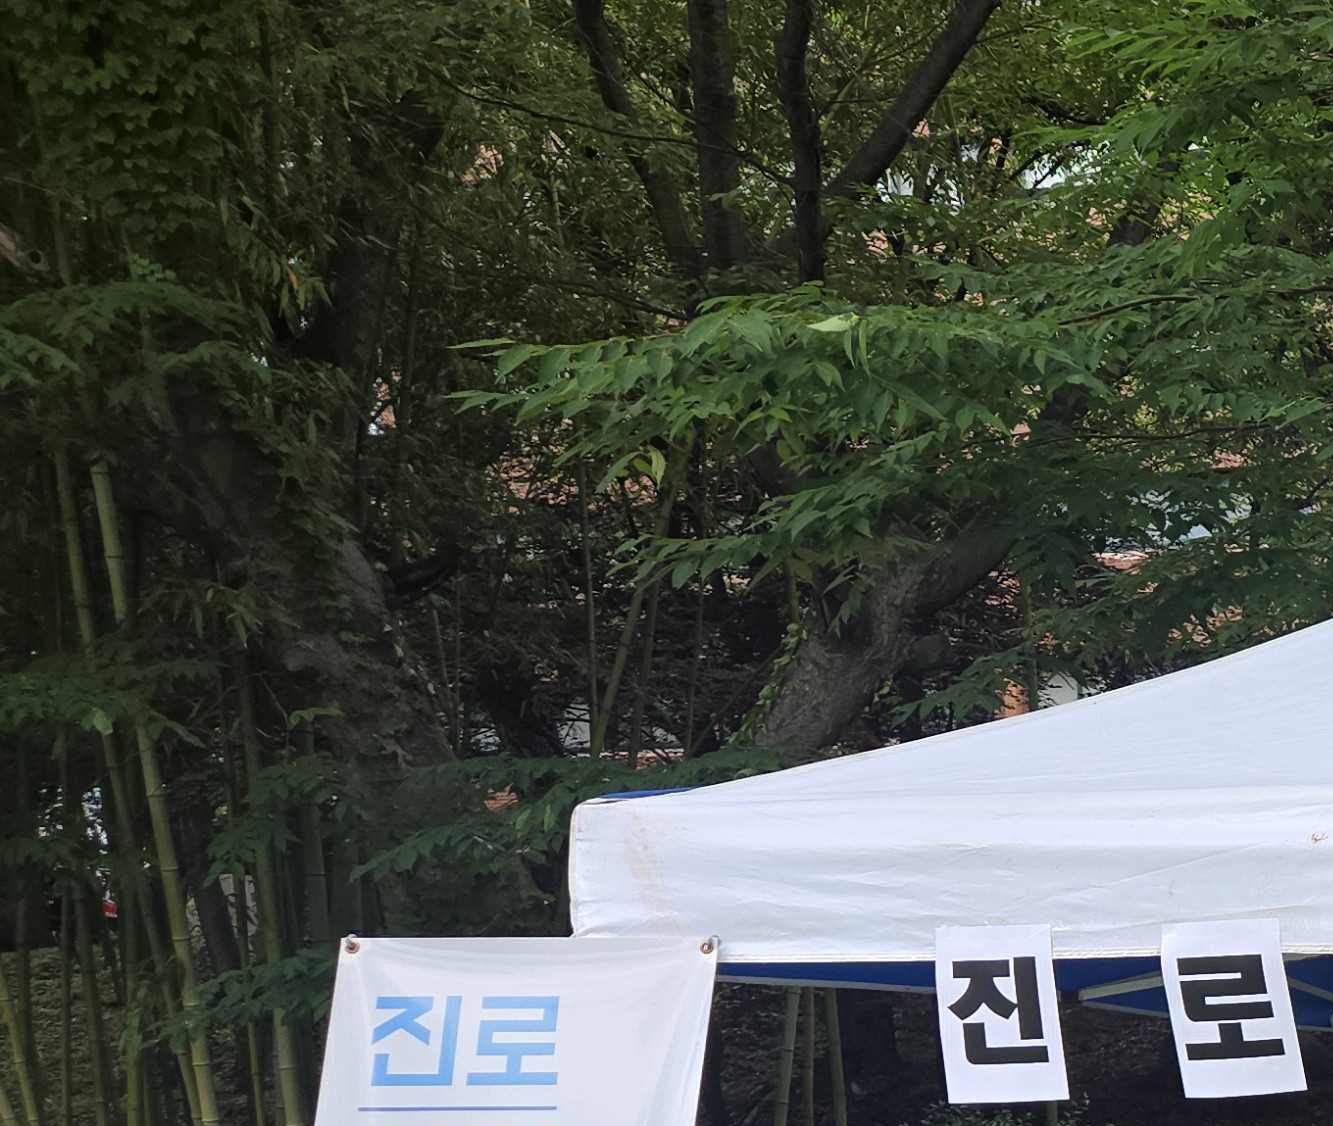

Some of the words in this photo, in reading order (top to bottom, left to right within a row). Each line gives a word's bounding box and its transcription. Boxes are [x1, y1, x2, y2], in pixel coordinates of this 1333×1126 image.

[370, 995, 560, 1086] 진로
[948, 956, 1050, 1065] 진
[1177, 955, 1286, 1062] 로
